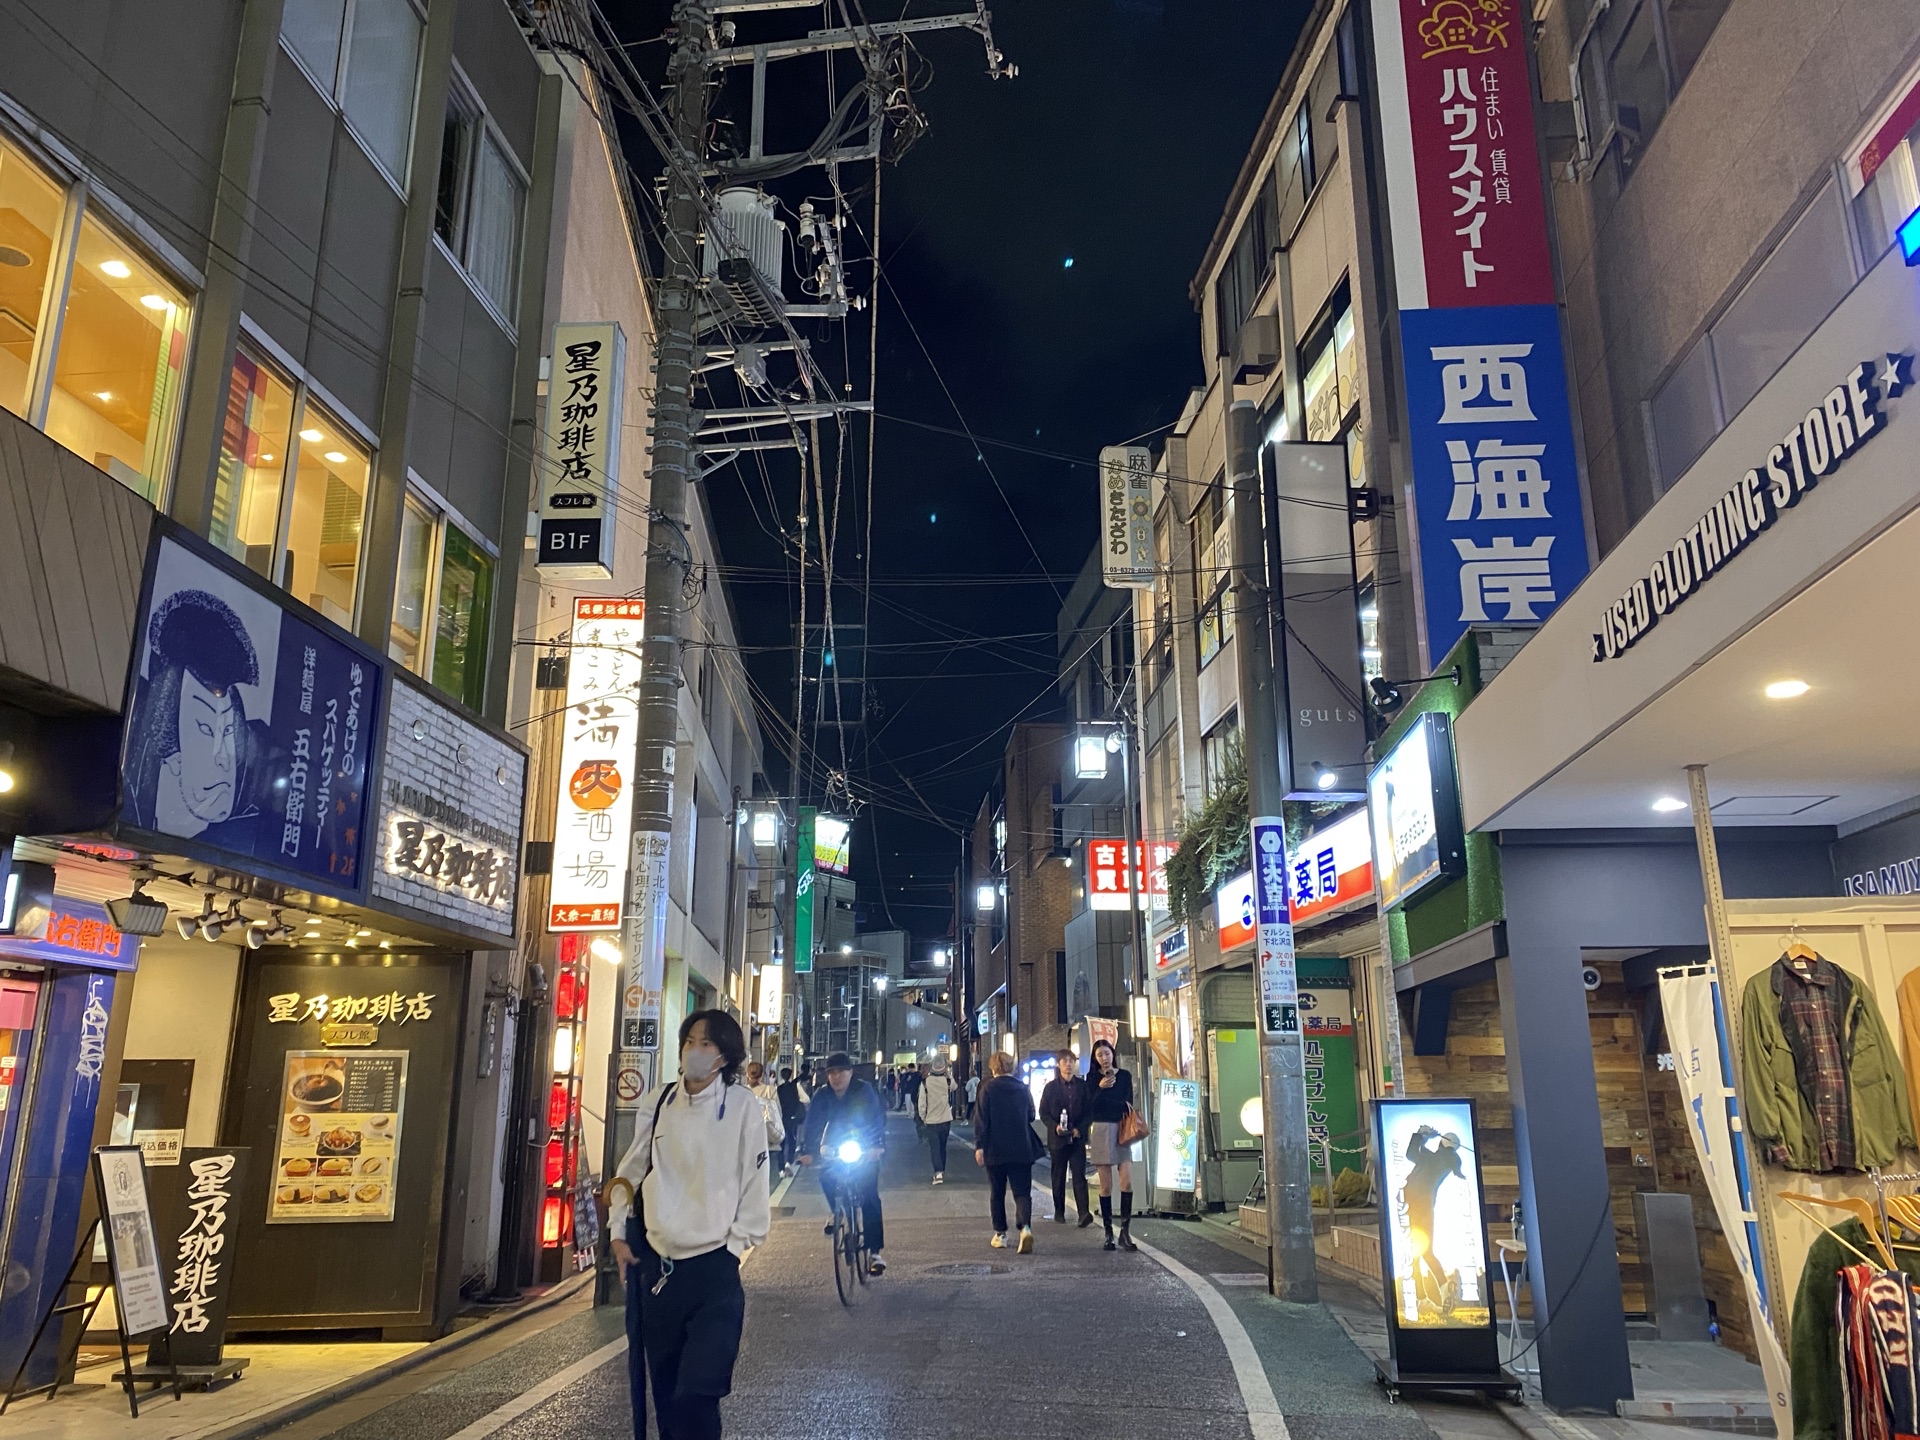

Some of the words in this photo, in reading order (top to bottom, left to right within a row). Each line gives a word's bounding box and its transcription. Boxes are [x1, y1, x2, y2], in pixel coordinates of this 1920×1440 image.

[1480, 66, 1504, 141] 住まい
[1439, 67, 1495, 288] ハウスメイト
[1489, 149, 1512, 205] 賃貸
[555, 340, 602, 487] 星乃珈琲店
[1129, 453, 1149, 490] 麻雀
[1429, 343, 1557, 621] 西海岸
[554, 496, 591, 506] スフレ館
[1107, 458, 1129, 555] かめきたざわ
[1600, 578, 1652, 659] USED
[1649, 468, 1771, 616] CLOTHING
[1766, 361, 1881, 509] STORE
[550, 532, 591, 551] B1F
[341, 662, 363, 776] ゆであげの
[1300, 707, 1357, 727] guts
[280, 728, 311, 859] 五右衛門
[314, 698, 338, 850] スパゲッティー
[394, 820, 513, 906] 星乃珈琲店
[1288, 847, 1338, 906] 薬局
[554, 907, 617, 923] 大衆一直線
[630, 861, 650, 985] 心理カウンセリング
[1262, 928, 1291, 937] マルシェ
[267, 990, 437, 1027] 星乃珈琲店
[629, 1025, 655, 1034] 北沢
[1271, 1009, 1295, 1018] 北沢
[1274, 1020, 1295, 1029] 2-11
[1302, 1016, 1342, 1031] 薬局
[328, 1029, 370, 1041] スフレ館
[630, 1035, 653, 1044] 2-12
[1163, 1082, 1195, 1100] 麻雀
[169, 1154, 236, 1335] 星乃珈琲店
